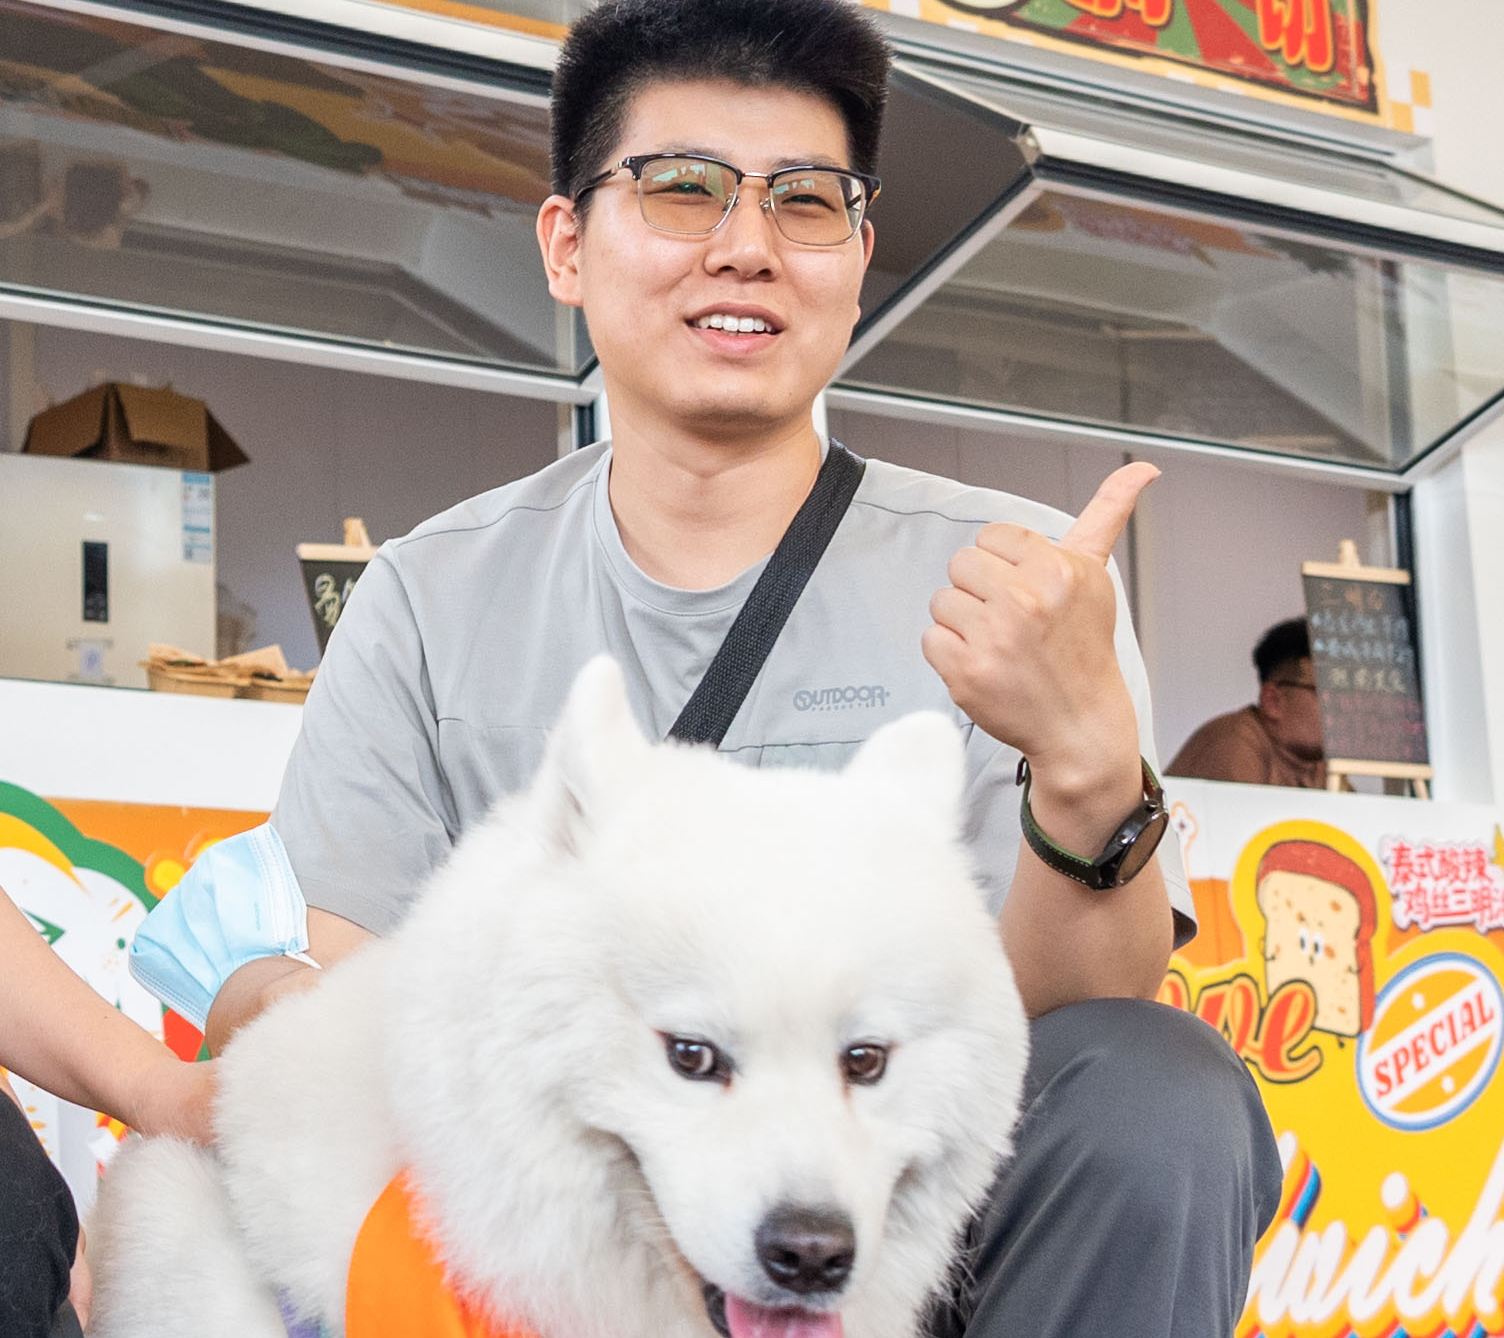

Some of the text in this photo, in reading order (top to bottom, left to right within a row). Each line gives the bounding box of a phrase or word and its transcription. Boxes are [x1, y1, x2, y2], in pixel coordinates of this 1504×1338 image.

[792, 684, 886, 711] OUTDOOR
[1392, 841, 1494, 887] 泰式酸辣
[1372, 989, 1496, 1101] SPECIAL
